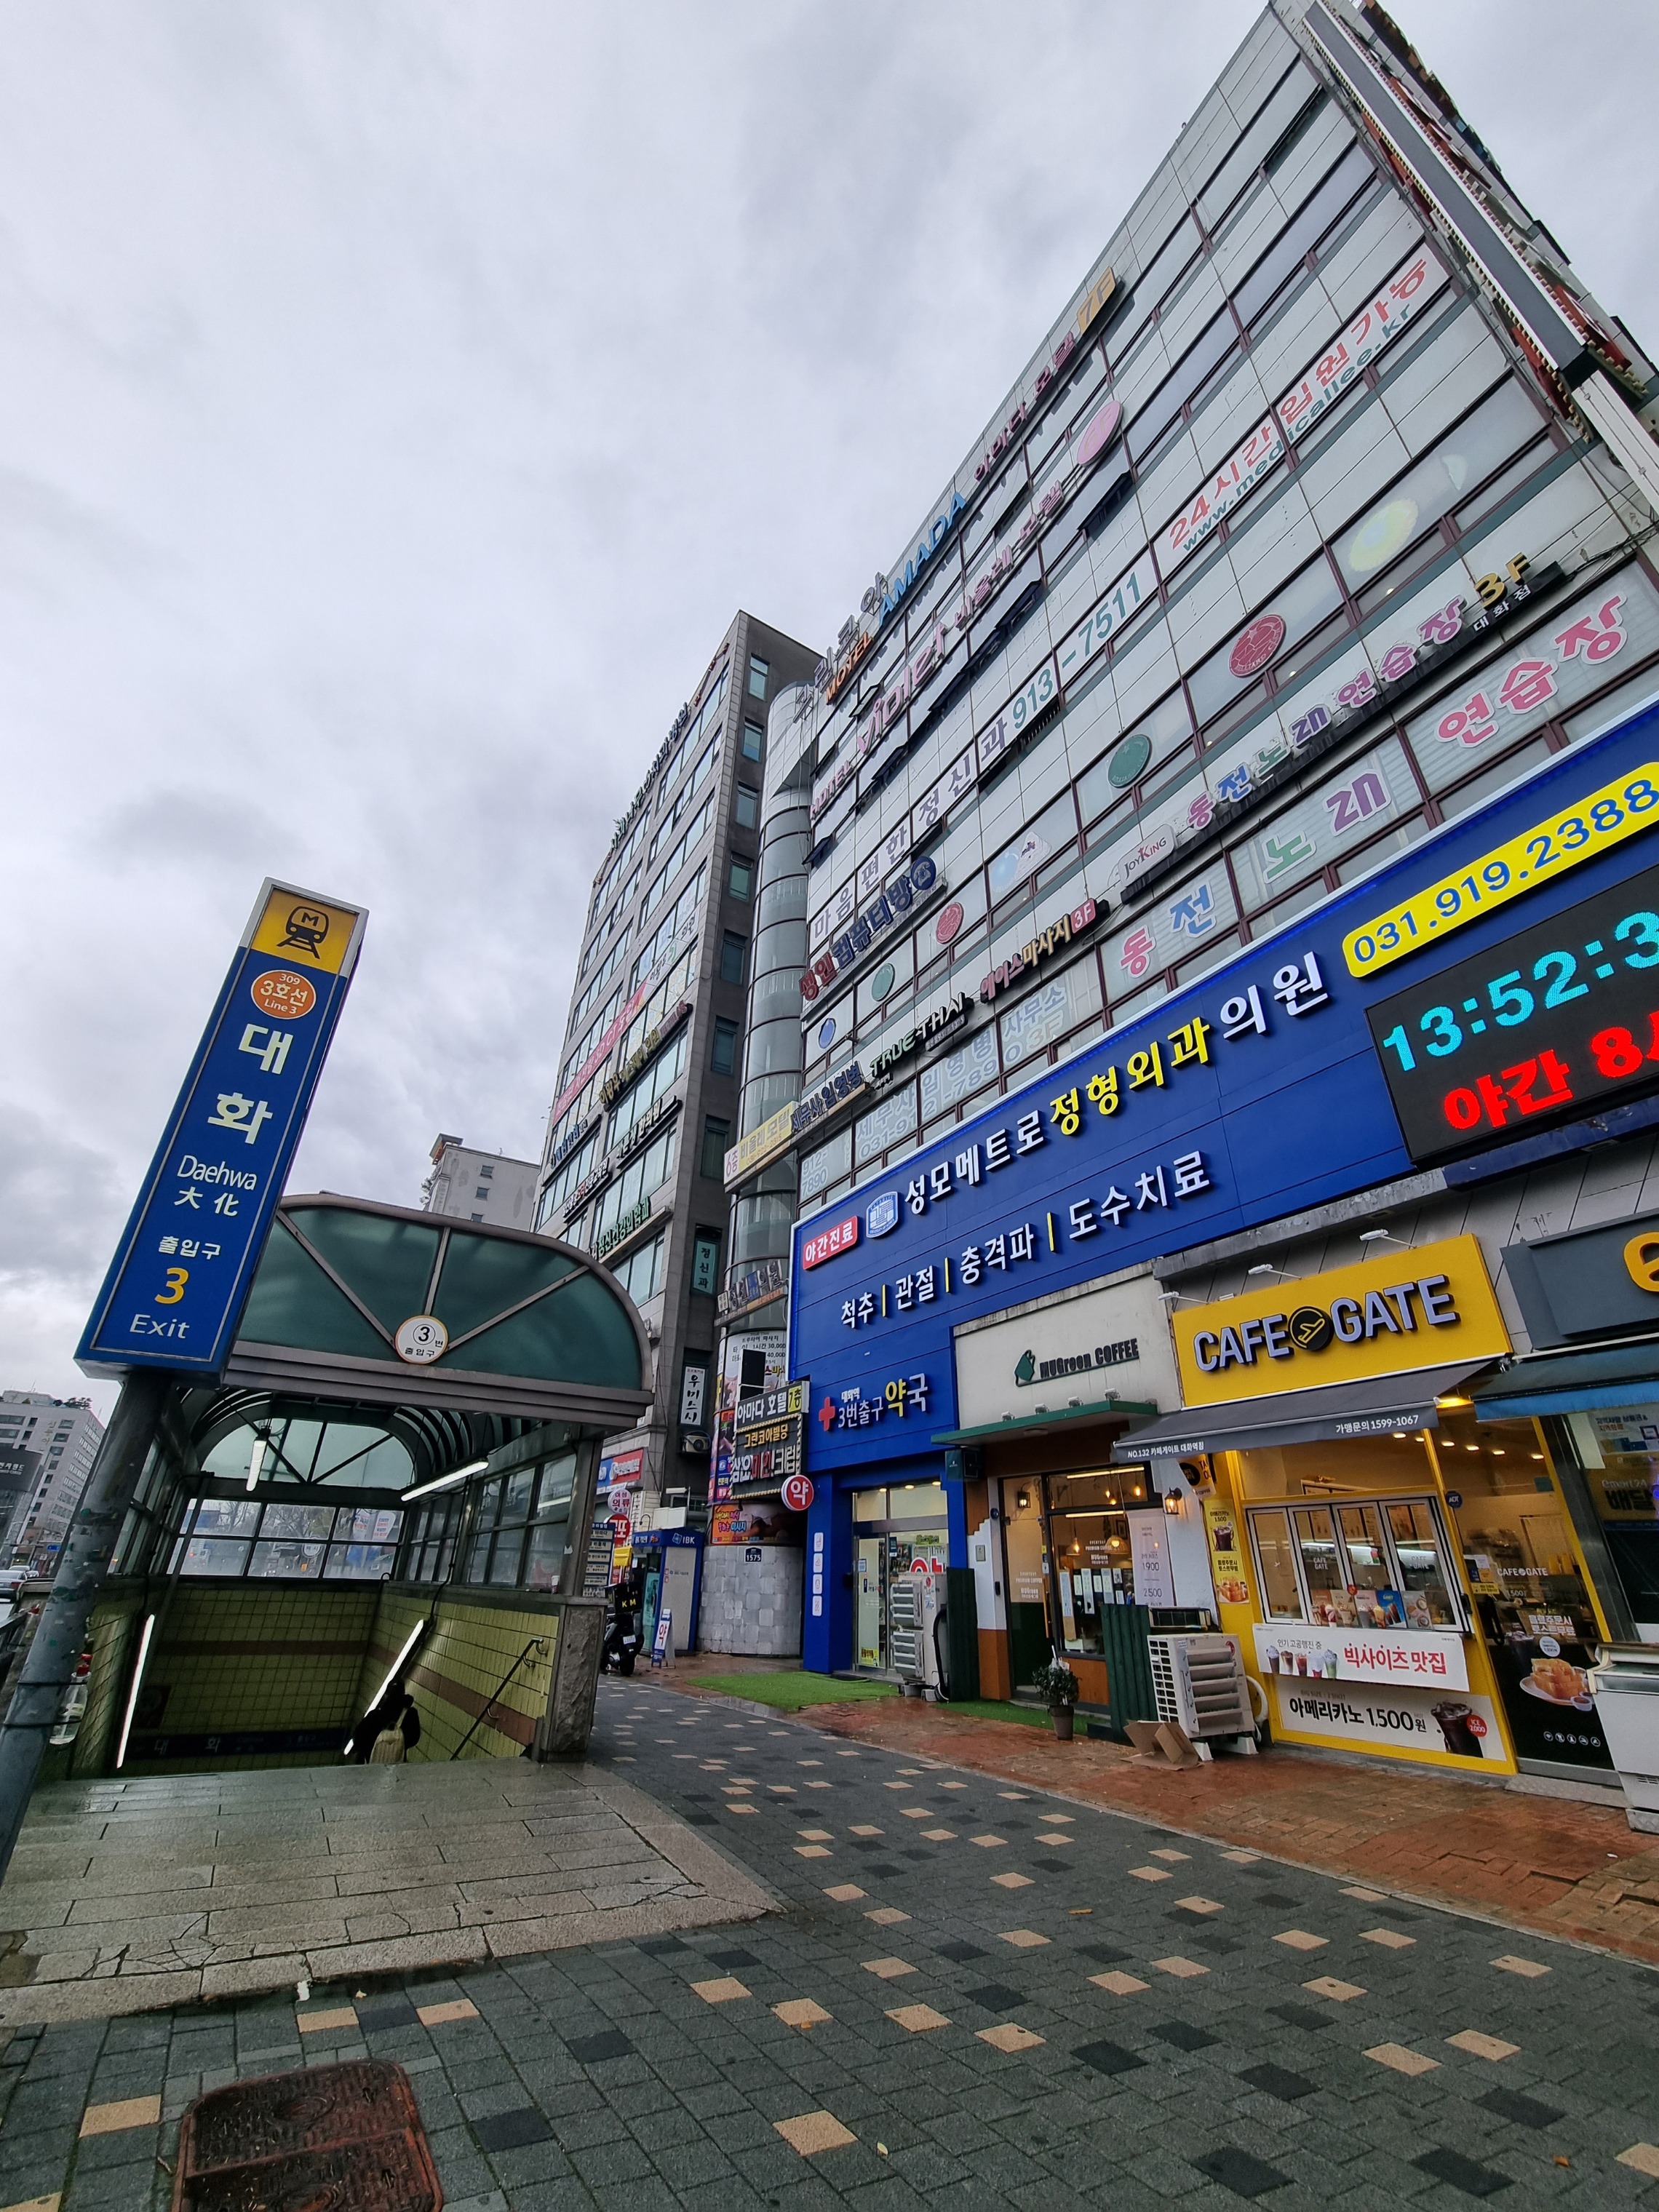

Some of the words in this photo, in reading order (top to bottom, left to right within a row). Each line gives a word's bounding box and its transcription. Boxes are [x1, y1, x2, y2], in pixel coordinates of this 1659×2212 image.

[1081, 280, 1114, 323] 7F
[1169, 424, 1274, 551] 24시간
[1279, 258, 1428, 425] 입원가능
[1019, 480, 1065, 541] 모텔
[1475, 552, 1531, 610] 3F
[826, 631, 873, 706] MOTEL
[880, 491, 968, 625] AMADA
[1473, 584, 1532, 633] 대화점
[918, 717, 1007, 827] 정신과
[1012, 572, 1142, 729] 913-7511
[1353, 778, 1659, 963] 031.919.2388
[1073, 903, 1093, 929] 3F
[279, 972, 301, 985] 309
[259, 980, 308, 1007] 3호선
[263, 998, 289, 1014] Line
[288, 1004, 297, 1014] 3
[916, 992, 965, 1038] THAI
[207, 1023, 294, 1145] 대화
[1444, 1049, 1574, 1130] 야간
[177, 1155, 257, 1191] Daehwa
[803, 1169, 827, 1195] 7890
[174, 1186, 239, 1218] 大化
[158, 1236, 220, 1260] 출입구
[805, 1222, 853, 1262] 야간진료
[841, 1292, 873, 1329] 척추
[895, 1265, 934, 1310] 관절
[960, 1225, 1034, 1284] 충격파
[1069, 1151, 1209, 1240] 도수치료
[698, 1247, 710, 1288] 정신과
[154, 1267, 189, 1304] 3
[130, 1314, 190, 1340] Exit
[1193, 1313, 1293, 1373] CAFE
[1330, 1273, 1459, 1343] GATE
[405, 1347, 435, 1357] 출입구
[1039, 1353, 1092, 1379] MUGreen
[1094, 1337, 1139, 1365] COFFEE
[738, 1399, 764, 1423] 아마다
[767, 1392, 786, 1415] 호텔
[838, 1396, 883, 1429] 3번출구
[885, 1373, 928, 1417] 약국
[841, 1388, 860, 1402] 대화역
[744, 1424, 788, 1448] 그린코아빌딩
[1335, 1420, 1369, 1435] 가맹문의
[1370, 1415, 1419, 1428] 1599-1067
[1128, 1447, 1150, 1459] NO.132
[1150, 1443, 1179, 1457] 카페게이트
[1180, 1441, 1204, 1453] 대화역점
[613, 1499, 630, 1508] 의류
[791, 1481, 808, 1505] 약
[683, 1536, 695, 1544] IBK
[1142, 1562, 1160, 1571] 1900
[1497, 1568, 1519, 1576] CAFE
[1527, 1567, 1548, 1576] GATE
[1143, 1588, 1162, 1598] 2500
[659, 1624, 667, 1646] 약
[1277, 1639, 1289, 1647] 인기
[1290, 1640, 1314, 1649] 고공행진
[1316, 1641, 1321, 1650] 중
[1344, 1643, 1409, 1671] 빅사이즈
[1411, 1651, 1447, 1674] 맛집
[1289, 1698, 1364, 1724] 아메리카노
[1471, 1719, 1480, 1727] ICE
